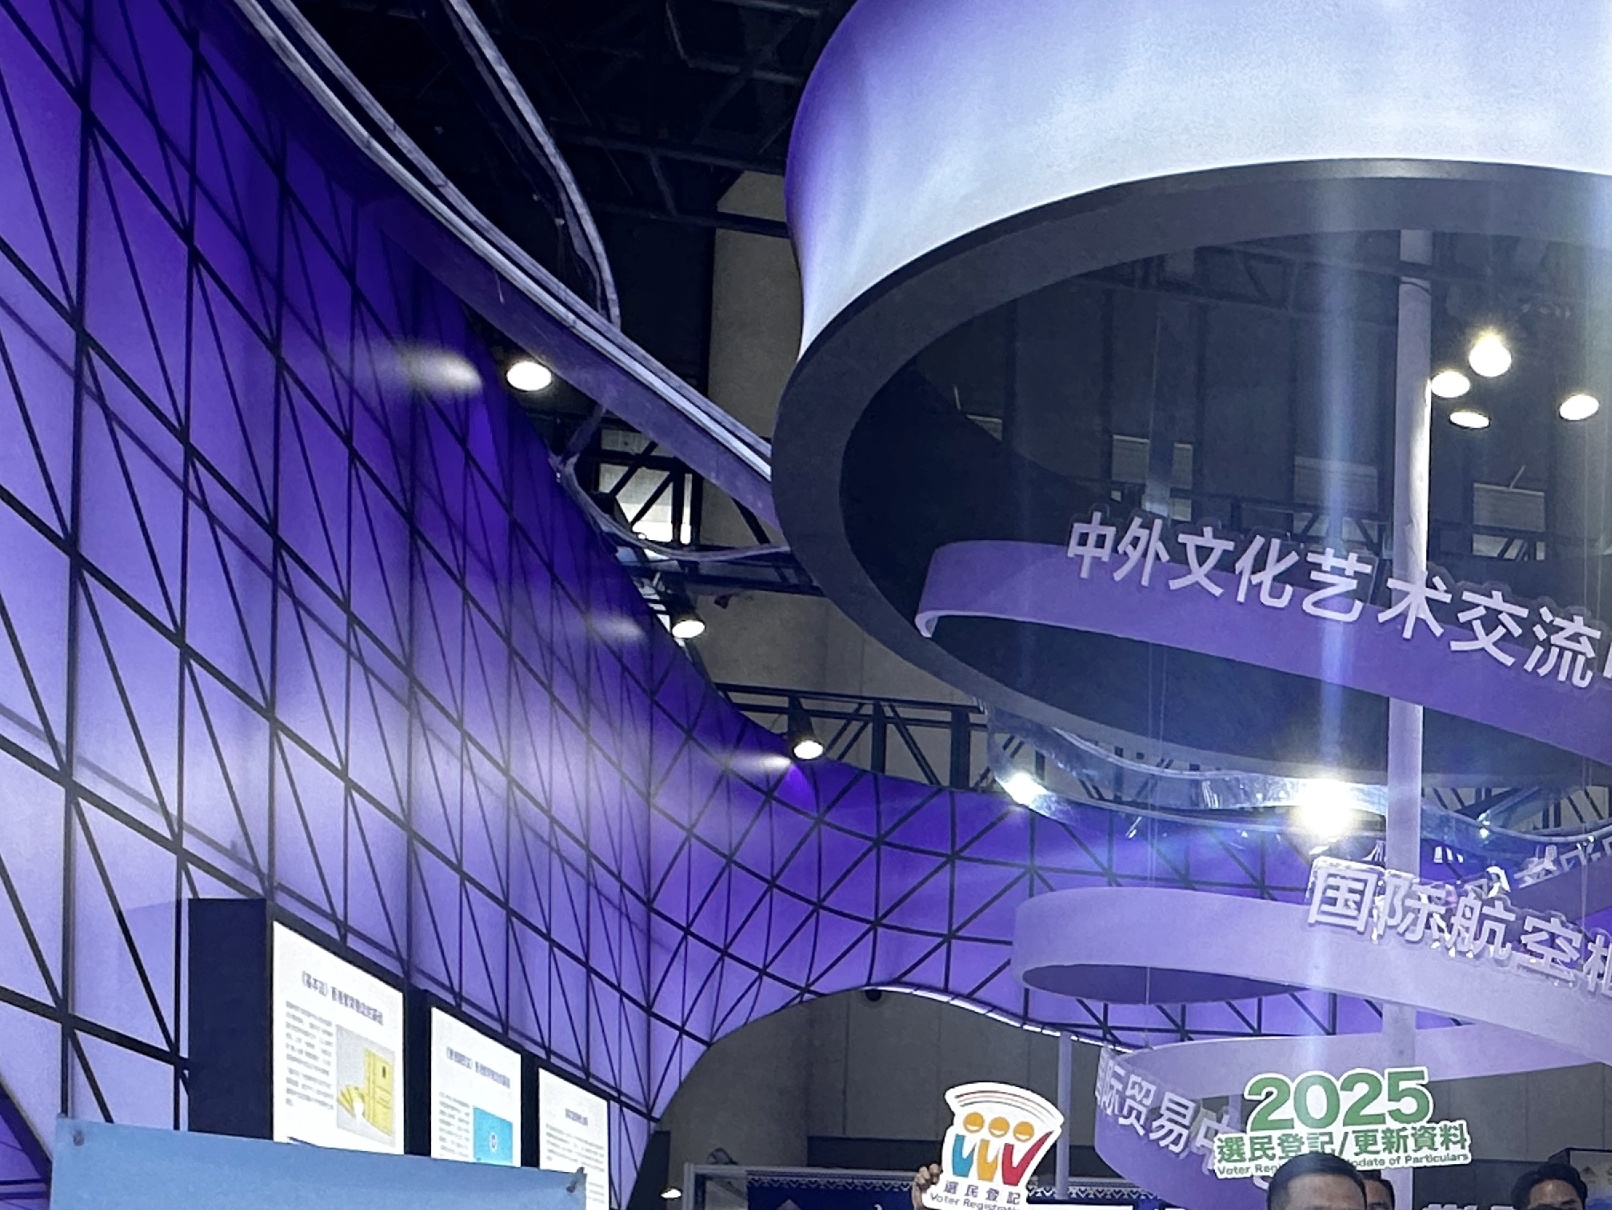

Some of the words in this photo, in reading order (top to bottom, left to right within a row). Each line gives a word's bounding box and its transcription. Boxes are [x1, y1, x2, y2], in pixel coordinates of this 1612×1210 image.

[1247, 1070, 1431, 1132] 2025
[1389, 1155, 1402, 1165] of
[1405, 1152, 1469, 1165] Particulars
[1218, 1166, 1250, 1176] Voter
[930, 1192, 960, 1206] Voter
